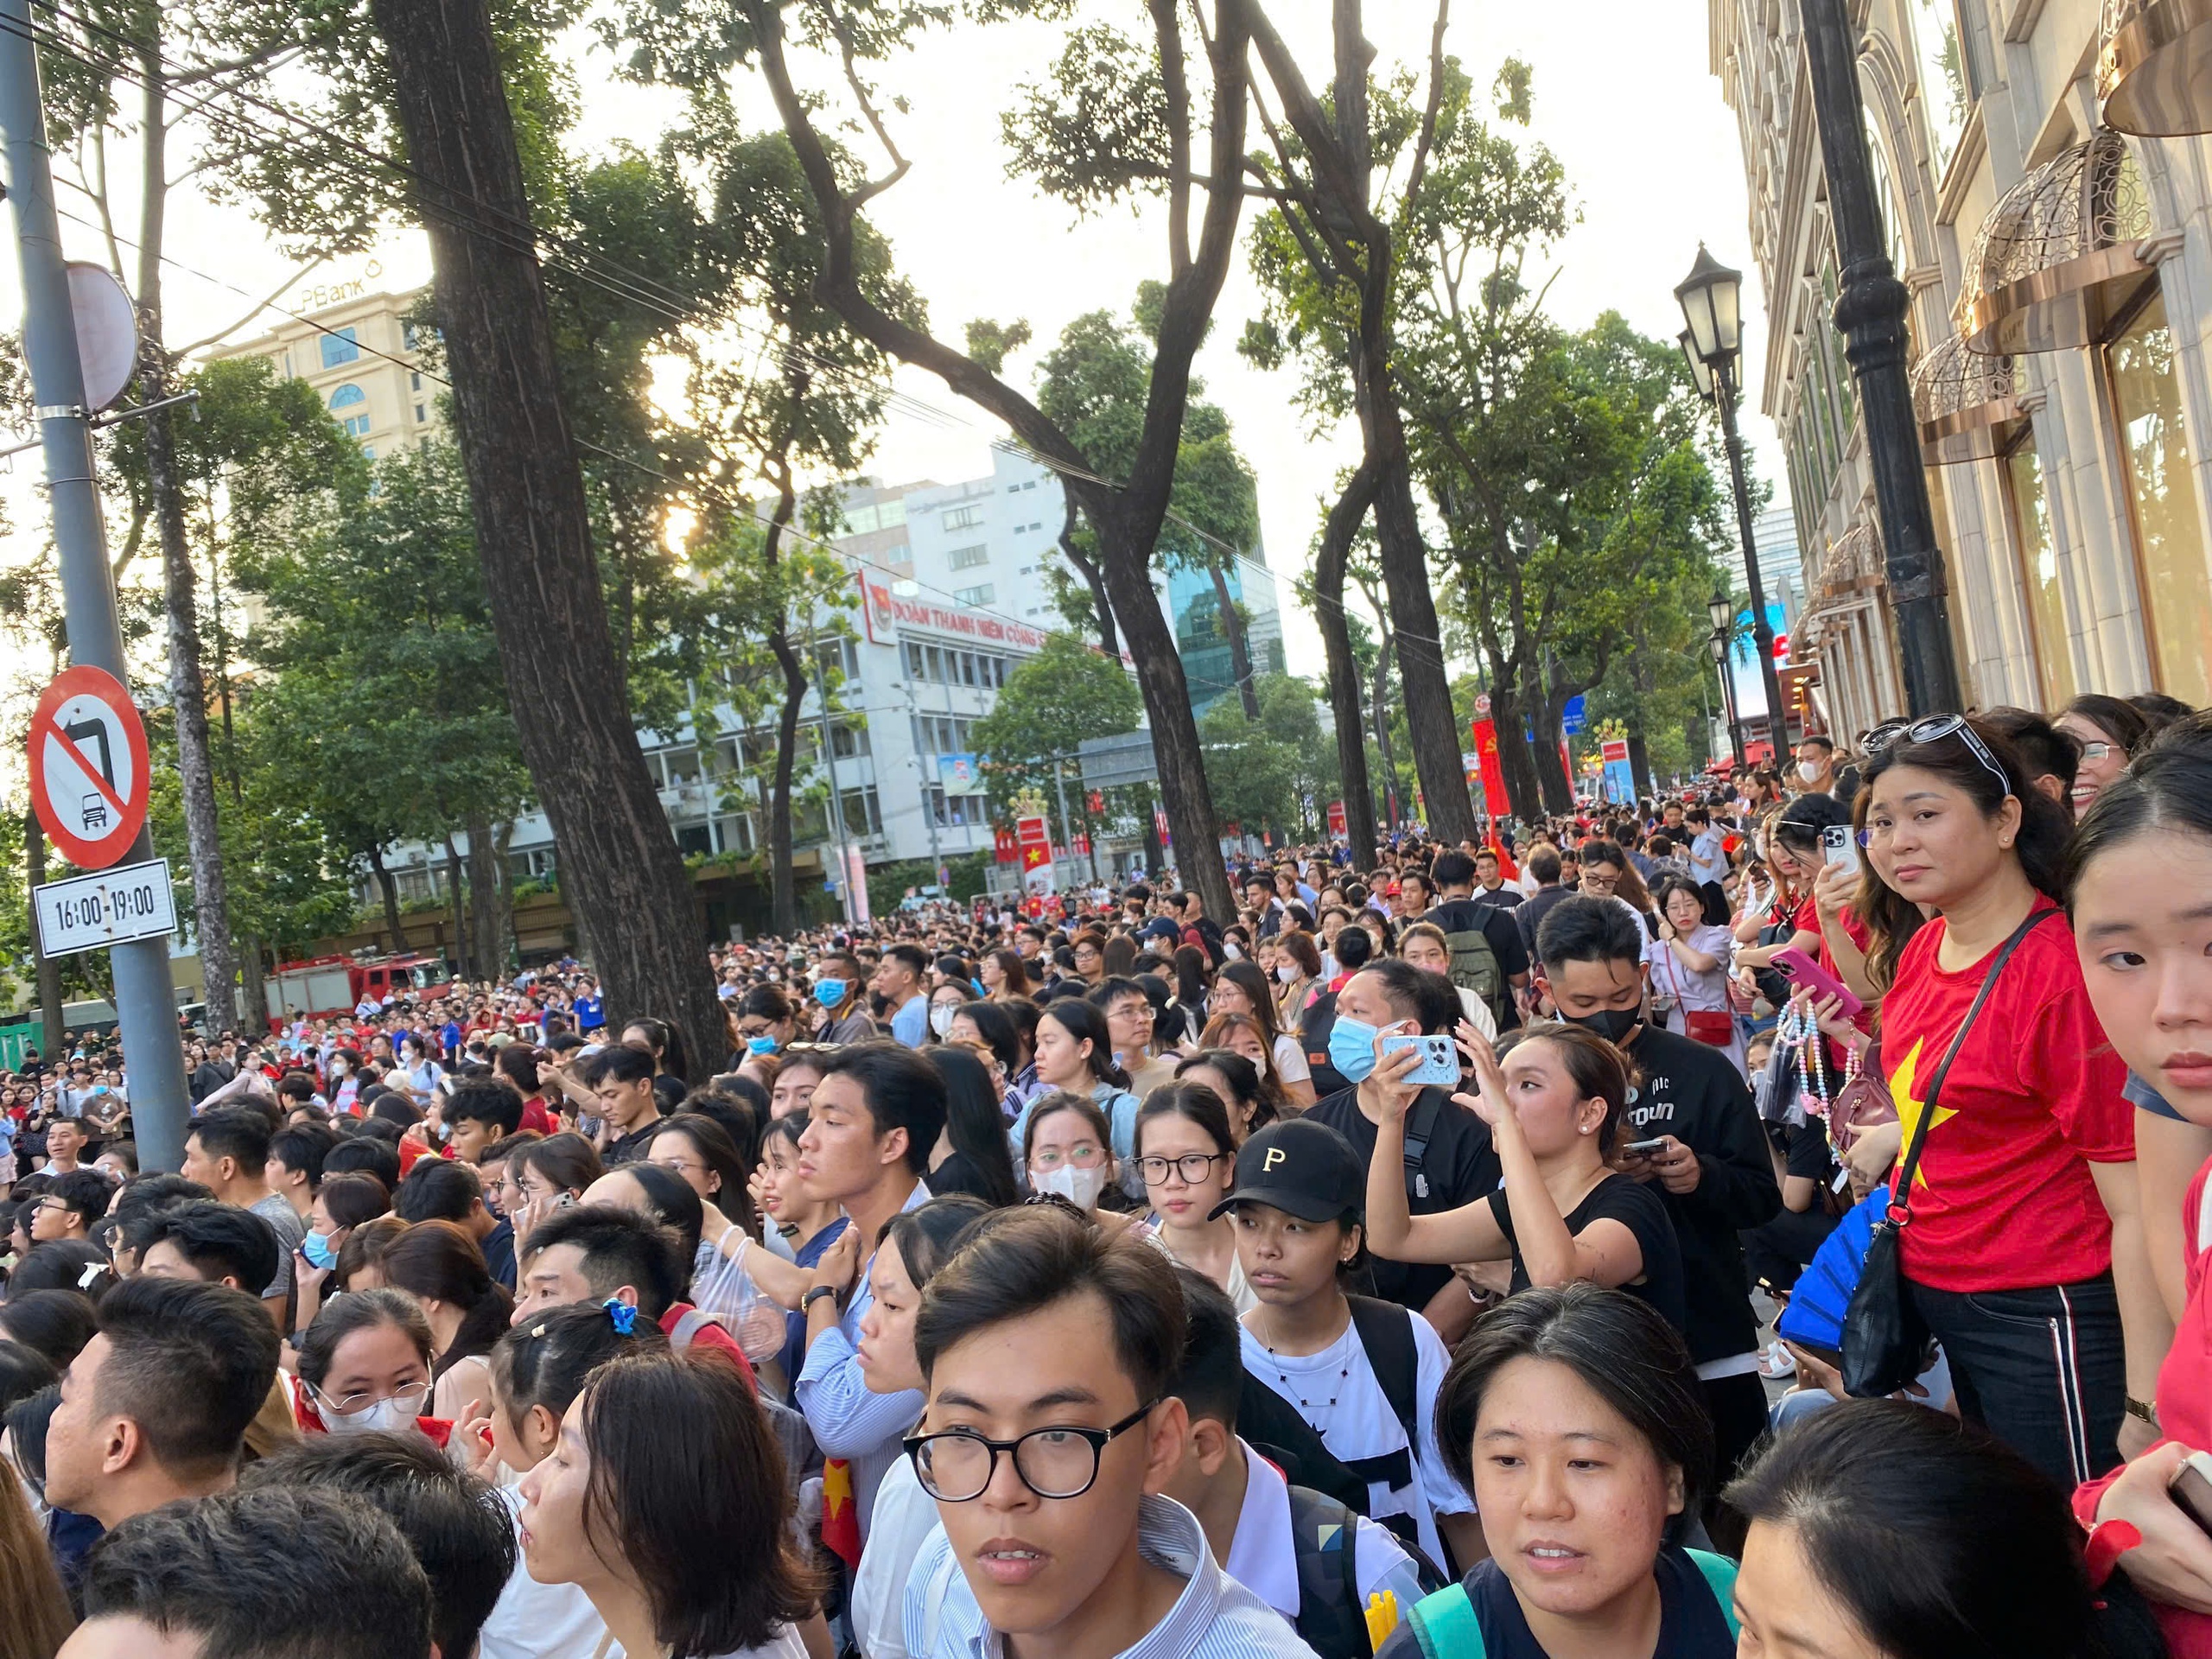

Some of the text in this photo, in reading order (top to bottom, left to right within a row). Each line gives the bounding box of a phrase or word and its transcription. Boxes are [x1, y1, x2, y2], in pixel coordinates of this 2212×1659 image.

[931, 609, 976, 634] THANH
[55, 885, 154, 931] 16:00-19:00
[1262, 1147, 1287, 1173] P
